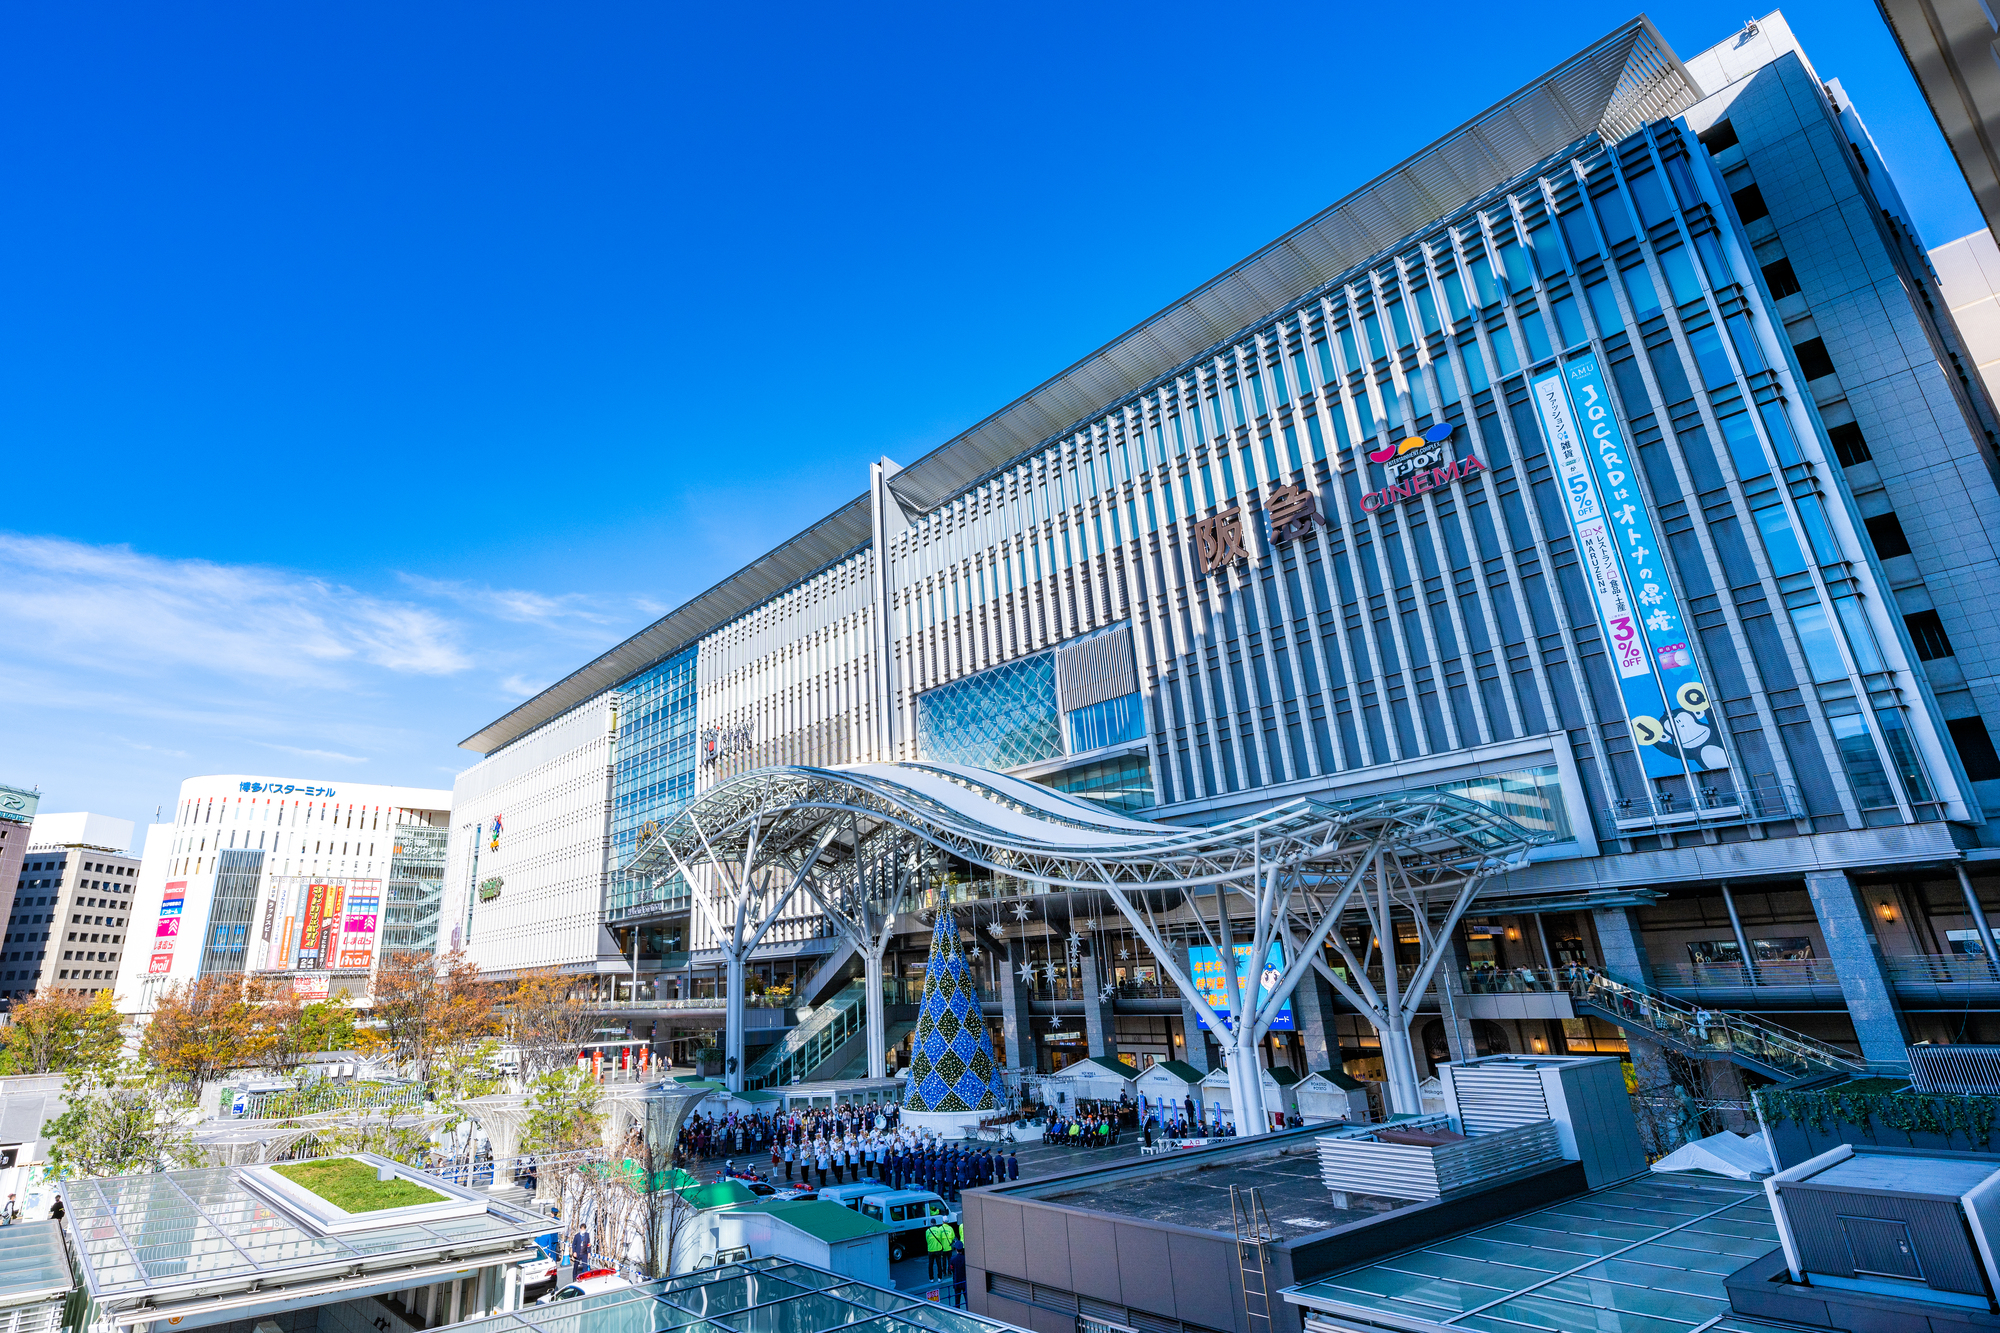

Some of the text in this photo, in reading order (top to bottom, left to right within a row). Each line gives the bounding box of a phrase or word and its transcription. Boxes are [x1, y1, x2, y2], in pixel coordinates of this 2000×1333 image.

[1571, 363, 1594, 379] AMU
[1419, 442, 1440, 454] COMPLEX
[1359, 454, 1486, 513] CINEMA
[1577, 505, 1594, 517] OFF
[1193, 484, 1326, 574] 阪急
[1596, 535, 1613, 570] レストラン
[1622, 656, 1642, 668] OFF
[1684, 688, 1707, 706] Q
[1636, 722, 1655, 742] J
[239, 781, 336, 798] 博多バスターミナル
[342, 936, 373, 946] しまむら
[149, 959, 170, 972] Avail
[340, 955, 370, 966] Avail
[1194, 960, 1227, 974] 年末年
[1196, 976, 1247, 991] 特別警活
